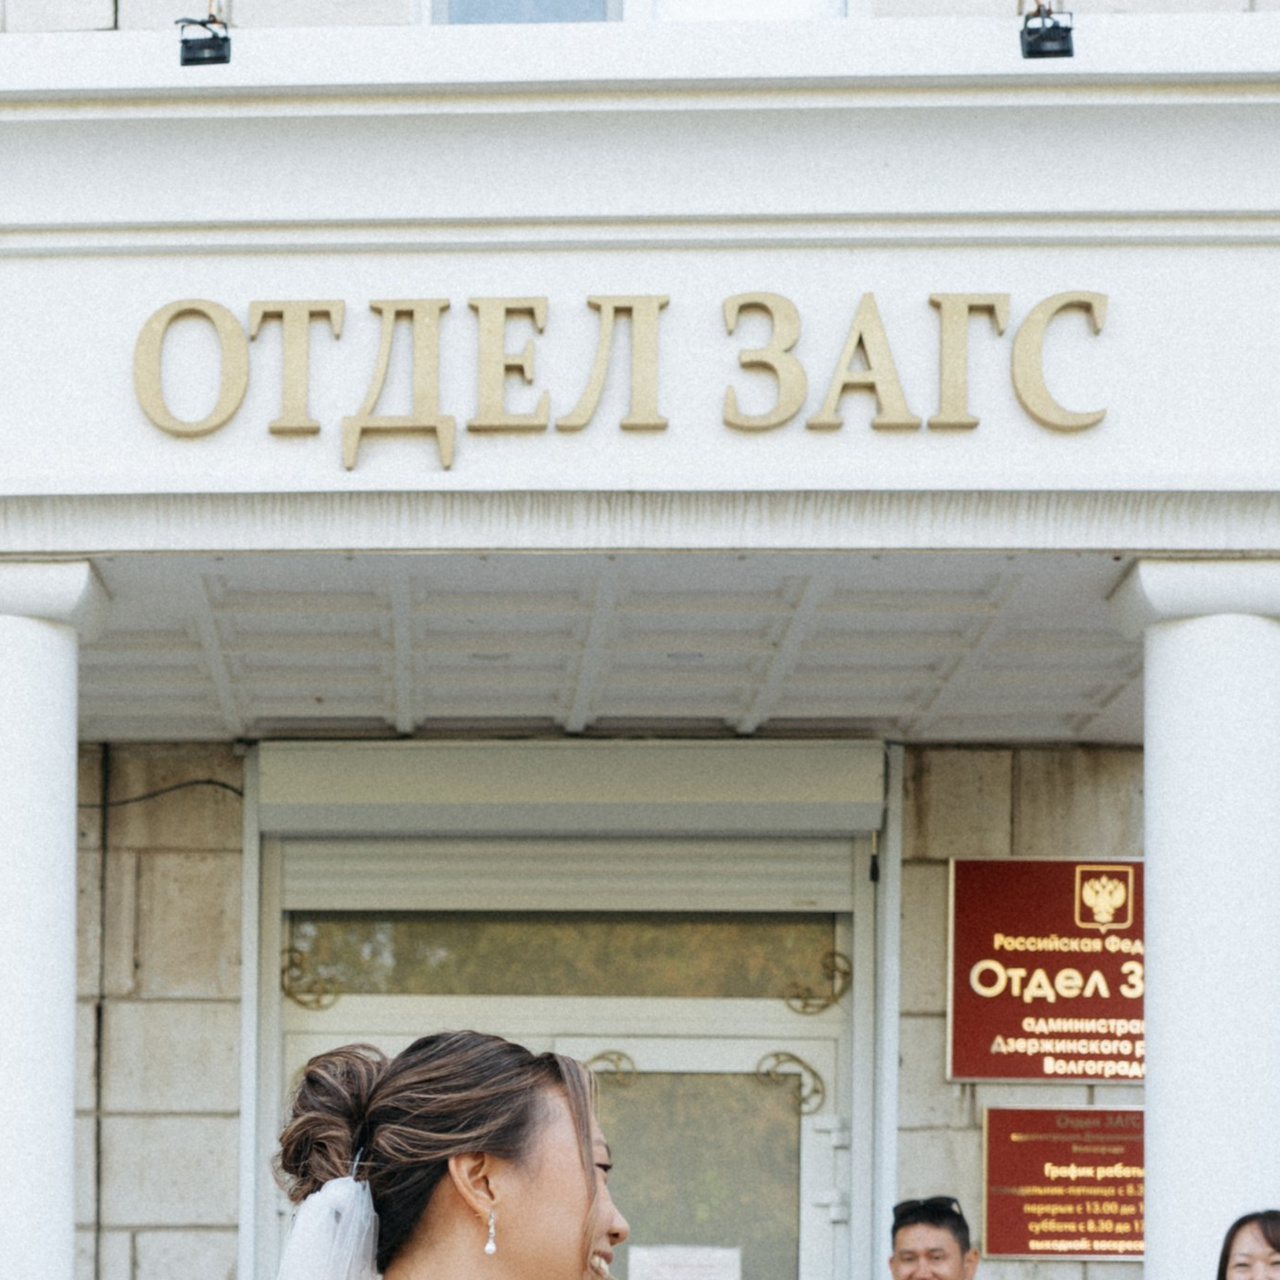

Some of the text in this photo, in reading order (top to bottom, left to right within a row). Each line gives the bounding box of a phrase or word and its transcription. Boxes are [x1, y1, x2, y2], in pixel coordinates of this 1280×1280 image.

[133, 291, 1109, 470] ОТДЕЛ ЗАГС
[993, 932, 1103, 952] Российская
[970, 959, 1110, 1003] Отдел
[1022, 1017, 1145, 1036] администра
[990, 1035, 1133, 1056] Дзержинского
[1044, 1162, 1094, 1181] График
